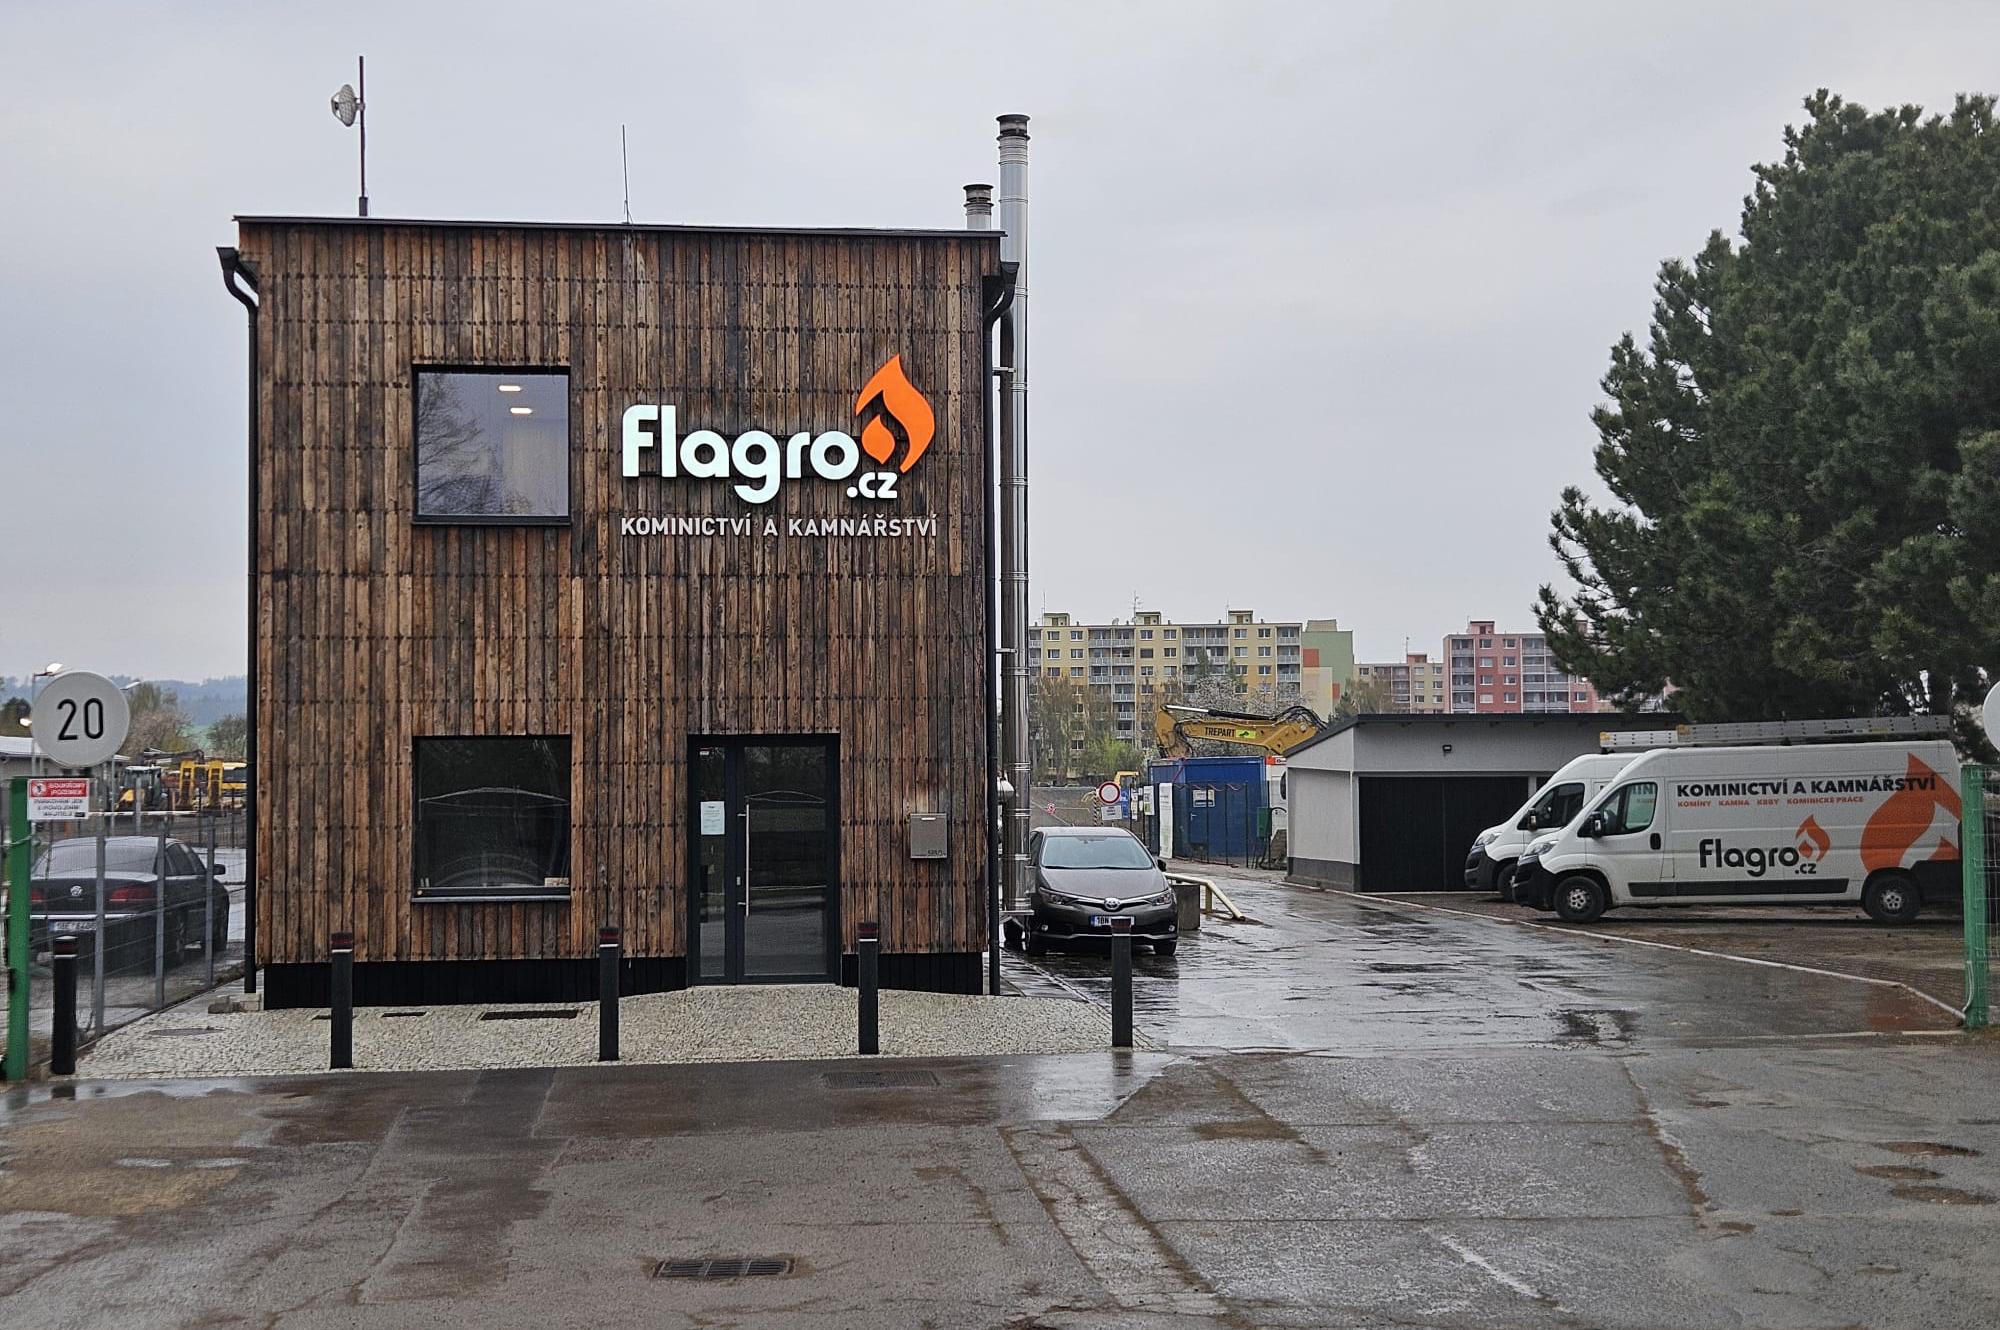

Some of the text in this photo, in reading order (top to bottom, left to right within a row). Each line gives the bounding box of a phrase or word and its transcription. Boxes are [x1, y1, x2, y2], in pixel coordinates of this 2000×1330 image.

[621, 513, 937, 538] KOMINICTVÍ A KAMNÁŘSTVÍ
[57, 697, 104, 742] 20
[1205, 727, 1236, 738] TREPART
[1677, 778, 1788, 798] KOMINICTVÍ
[1793, 780, 1807, 795] A
[1811, 775, 1936, 794] KAMNÁŘSTVÍ
